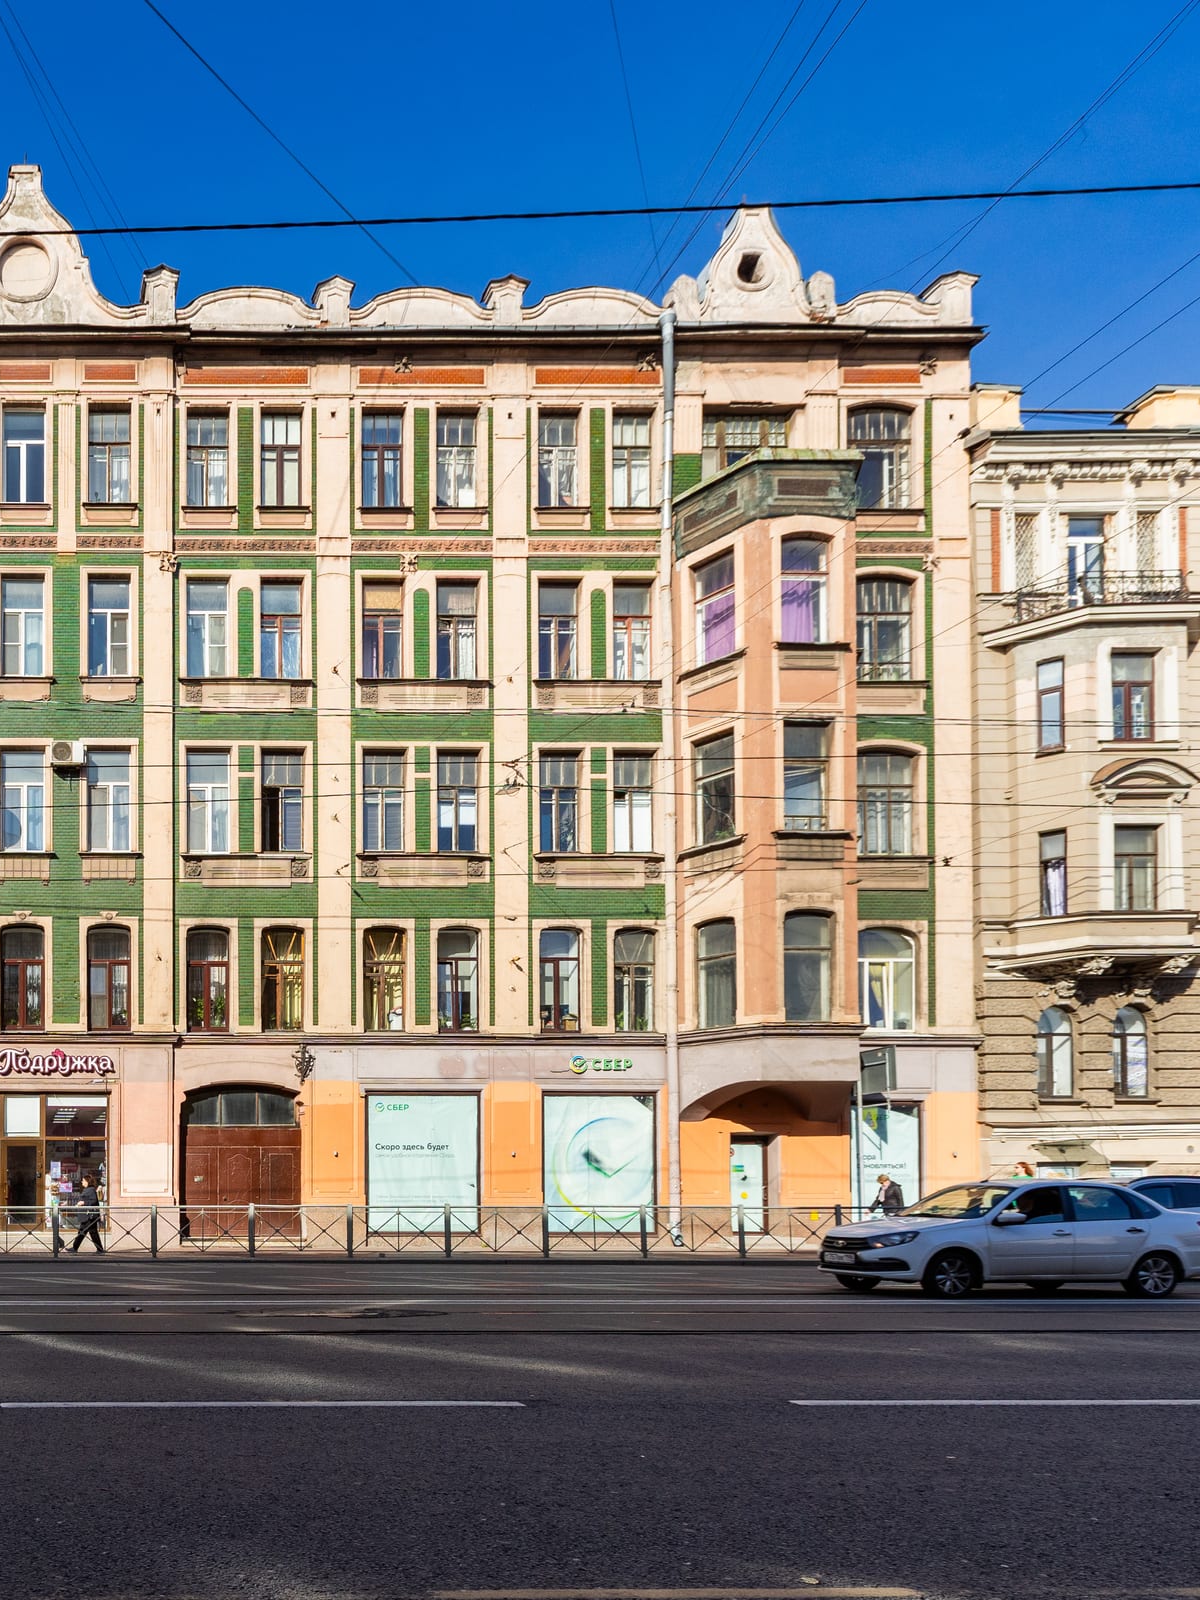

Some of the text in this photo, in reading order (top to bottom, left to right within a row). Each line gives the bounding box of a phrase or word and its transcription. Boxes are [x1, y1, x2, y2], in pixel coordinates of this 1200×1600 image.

[592, 1058, 633, 1071] СБЕР
[386, 1103, 410, 1111] СБЕР
[375, 1142, 449, 1152] Скоро здесь будет
